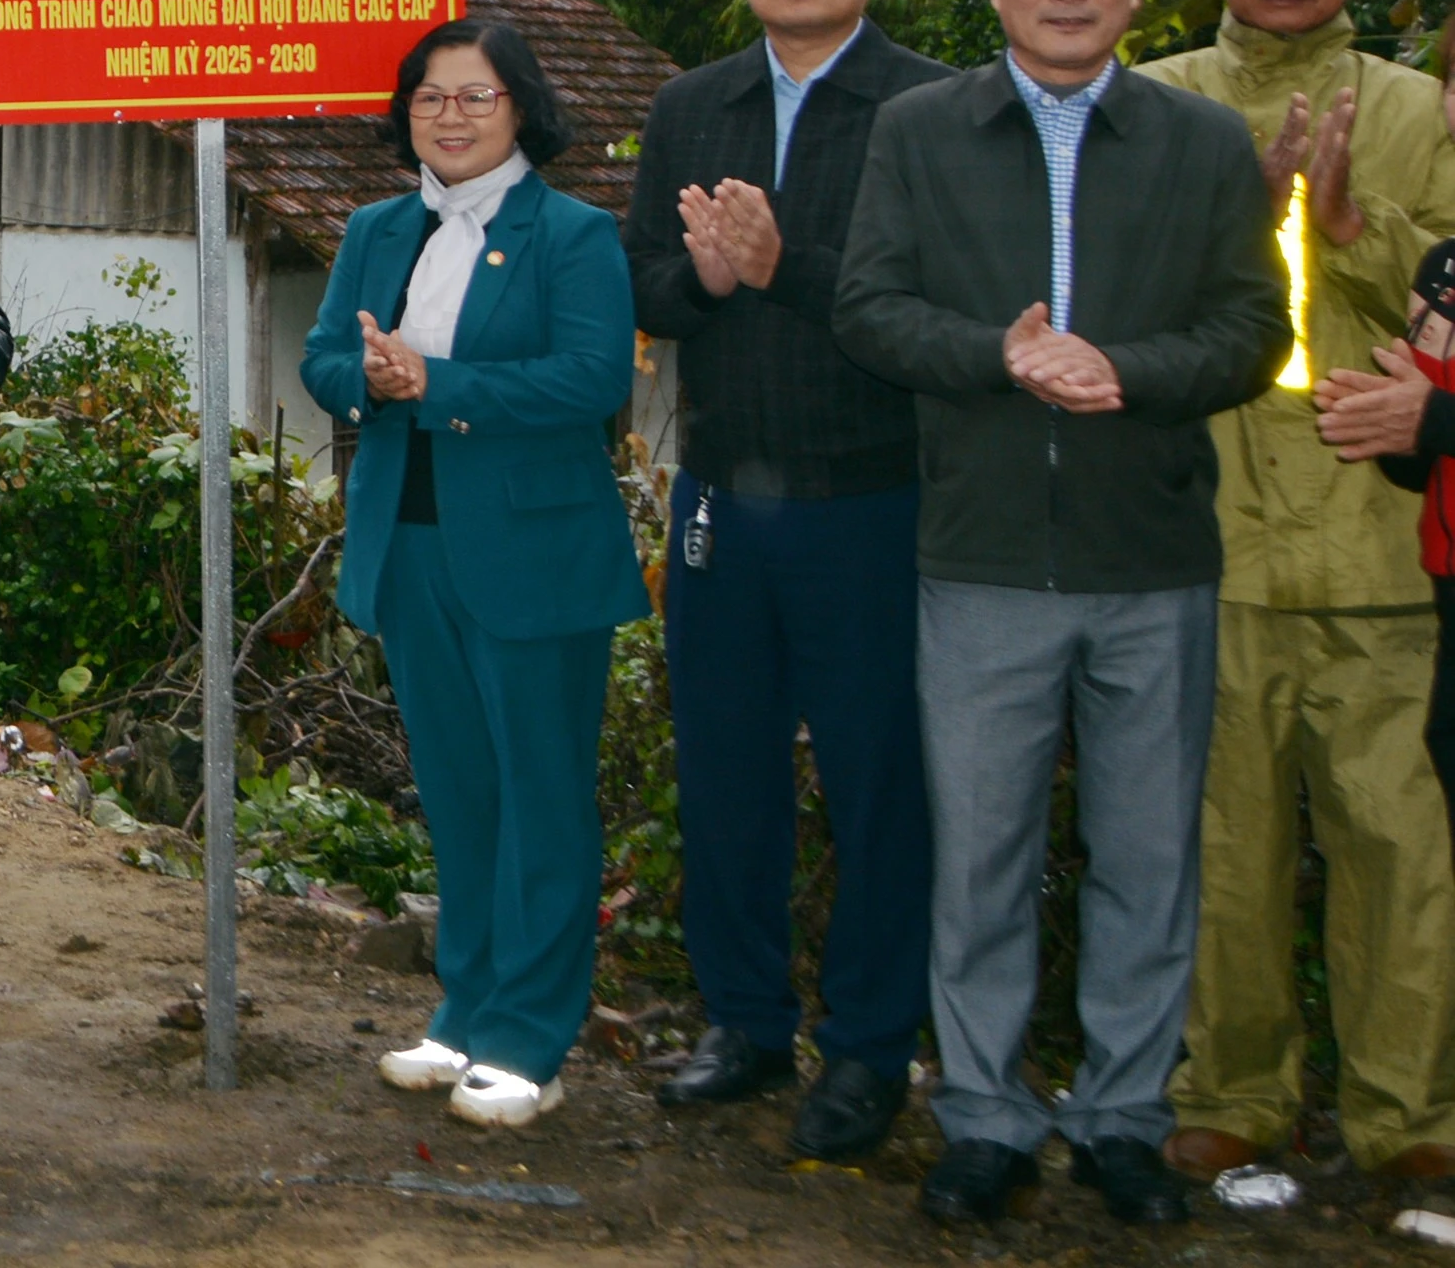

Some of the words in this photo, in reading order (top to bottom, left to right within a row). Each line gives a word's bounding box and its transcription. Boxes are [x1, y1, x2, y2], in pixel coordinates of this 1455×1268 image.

[105, 40, 170, 83] NHIỆM
[175, 39, 200, 76] KỲ
[205, 44, 252, 75] 2025
[256, 56, 265, 65] -
[270, 43, 317, 73] 2030
